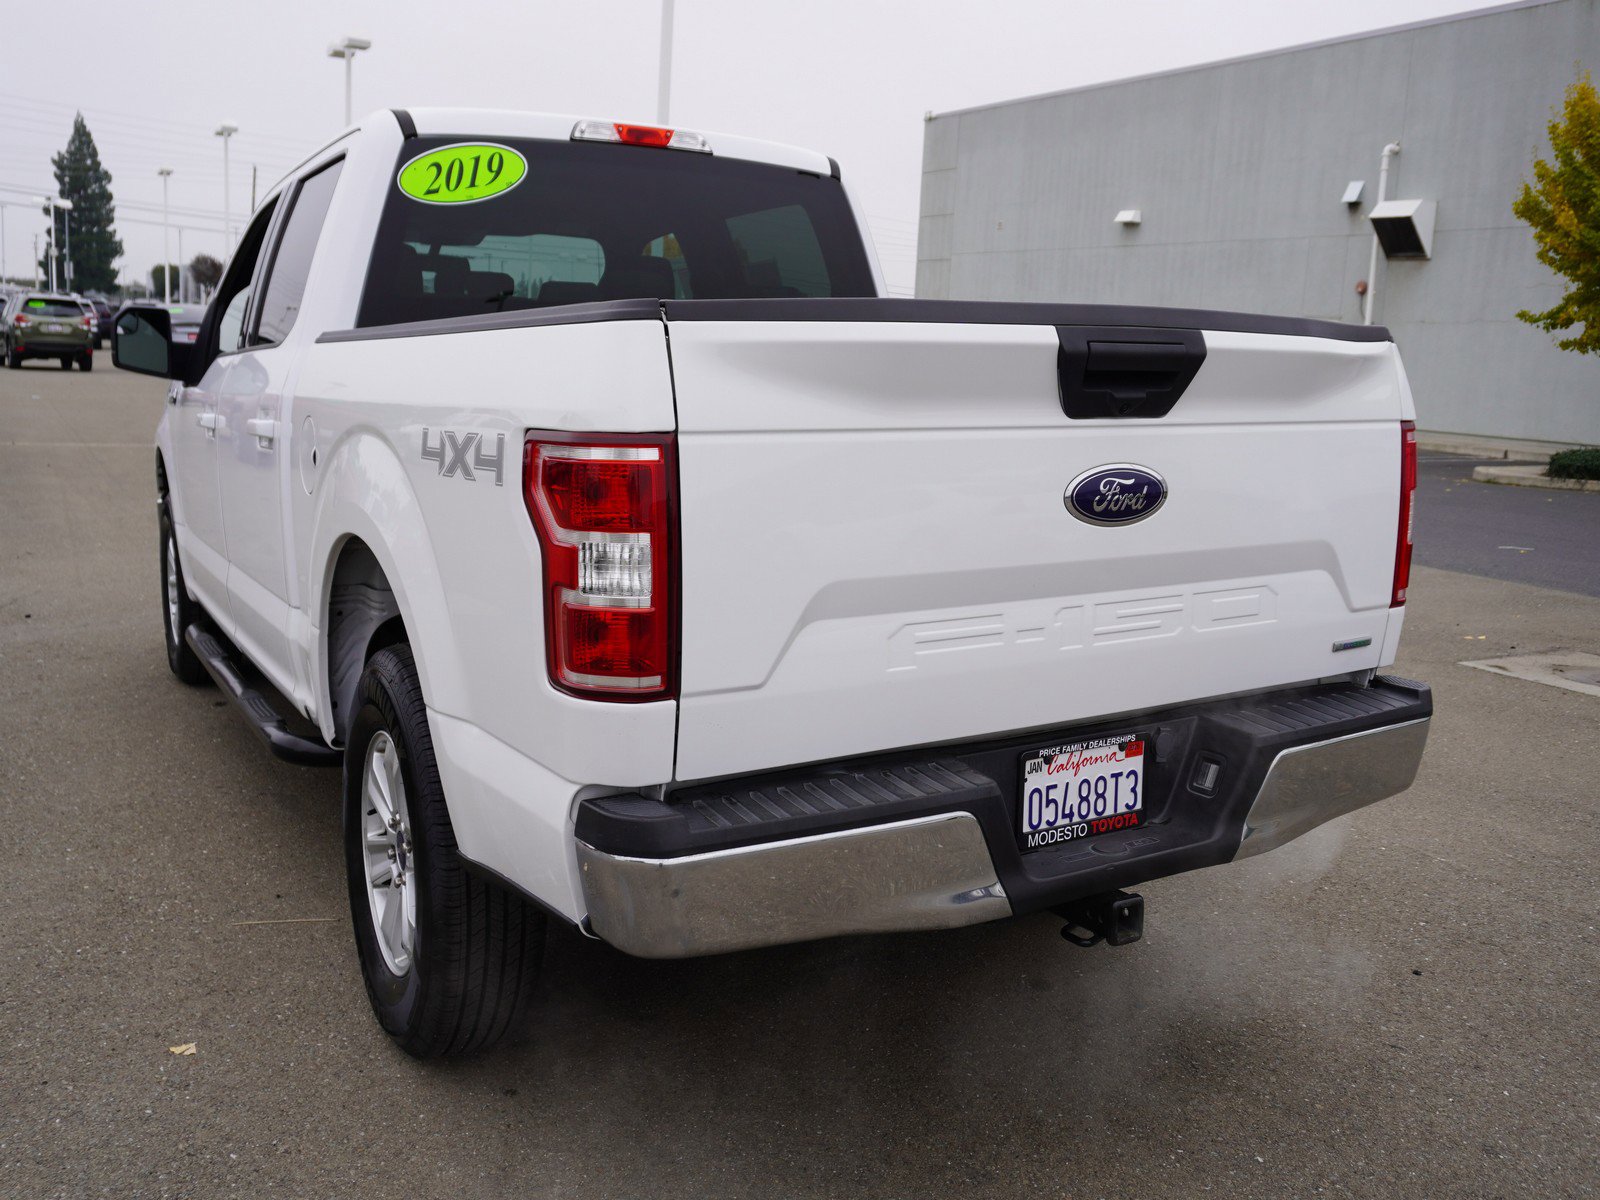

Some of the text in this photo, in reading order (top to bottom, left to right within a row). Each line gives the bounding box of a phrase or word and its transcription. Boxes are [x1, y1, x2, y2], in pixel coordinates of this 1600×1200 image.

[423, 151, 504, 195] 2019
[1093, 477, 1148, 512] Ford
[886, 585, 1279, 673] F-150
[1039, 746, 1061, 757] PRICE
[1062, 741, 1087, 754] FAMILY
[1088, 735, 1136, 749] DEALERSHIPS
[1047, 750, 1125, 777] California
[1027, 761, 1043, 775] JAN
[1028, 769, 1139, 831] 05488T3
[1027, 813, 1139, 848] MODESTO TOYOTA
